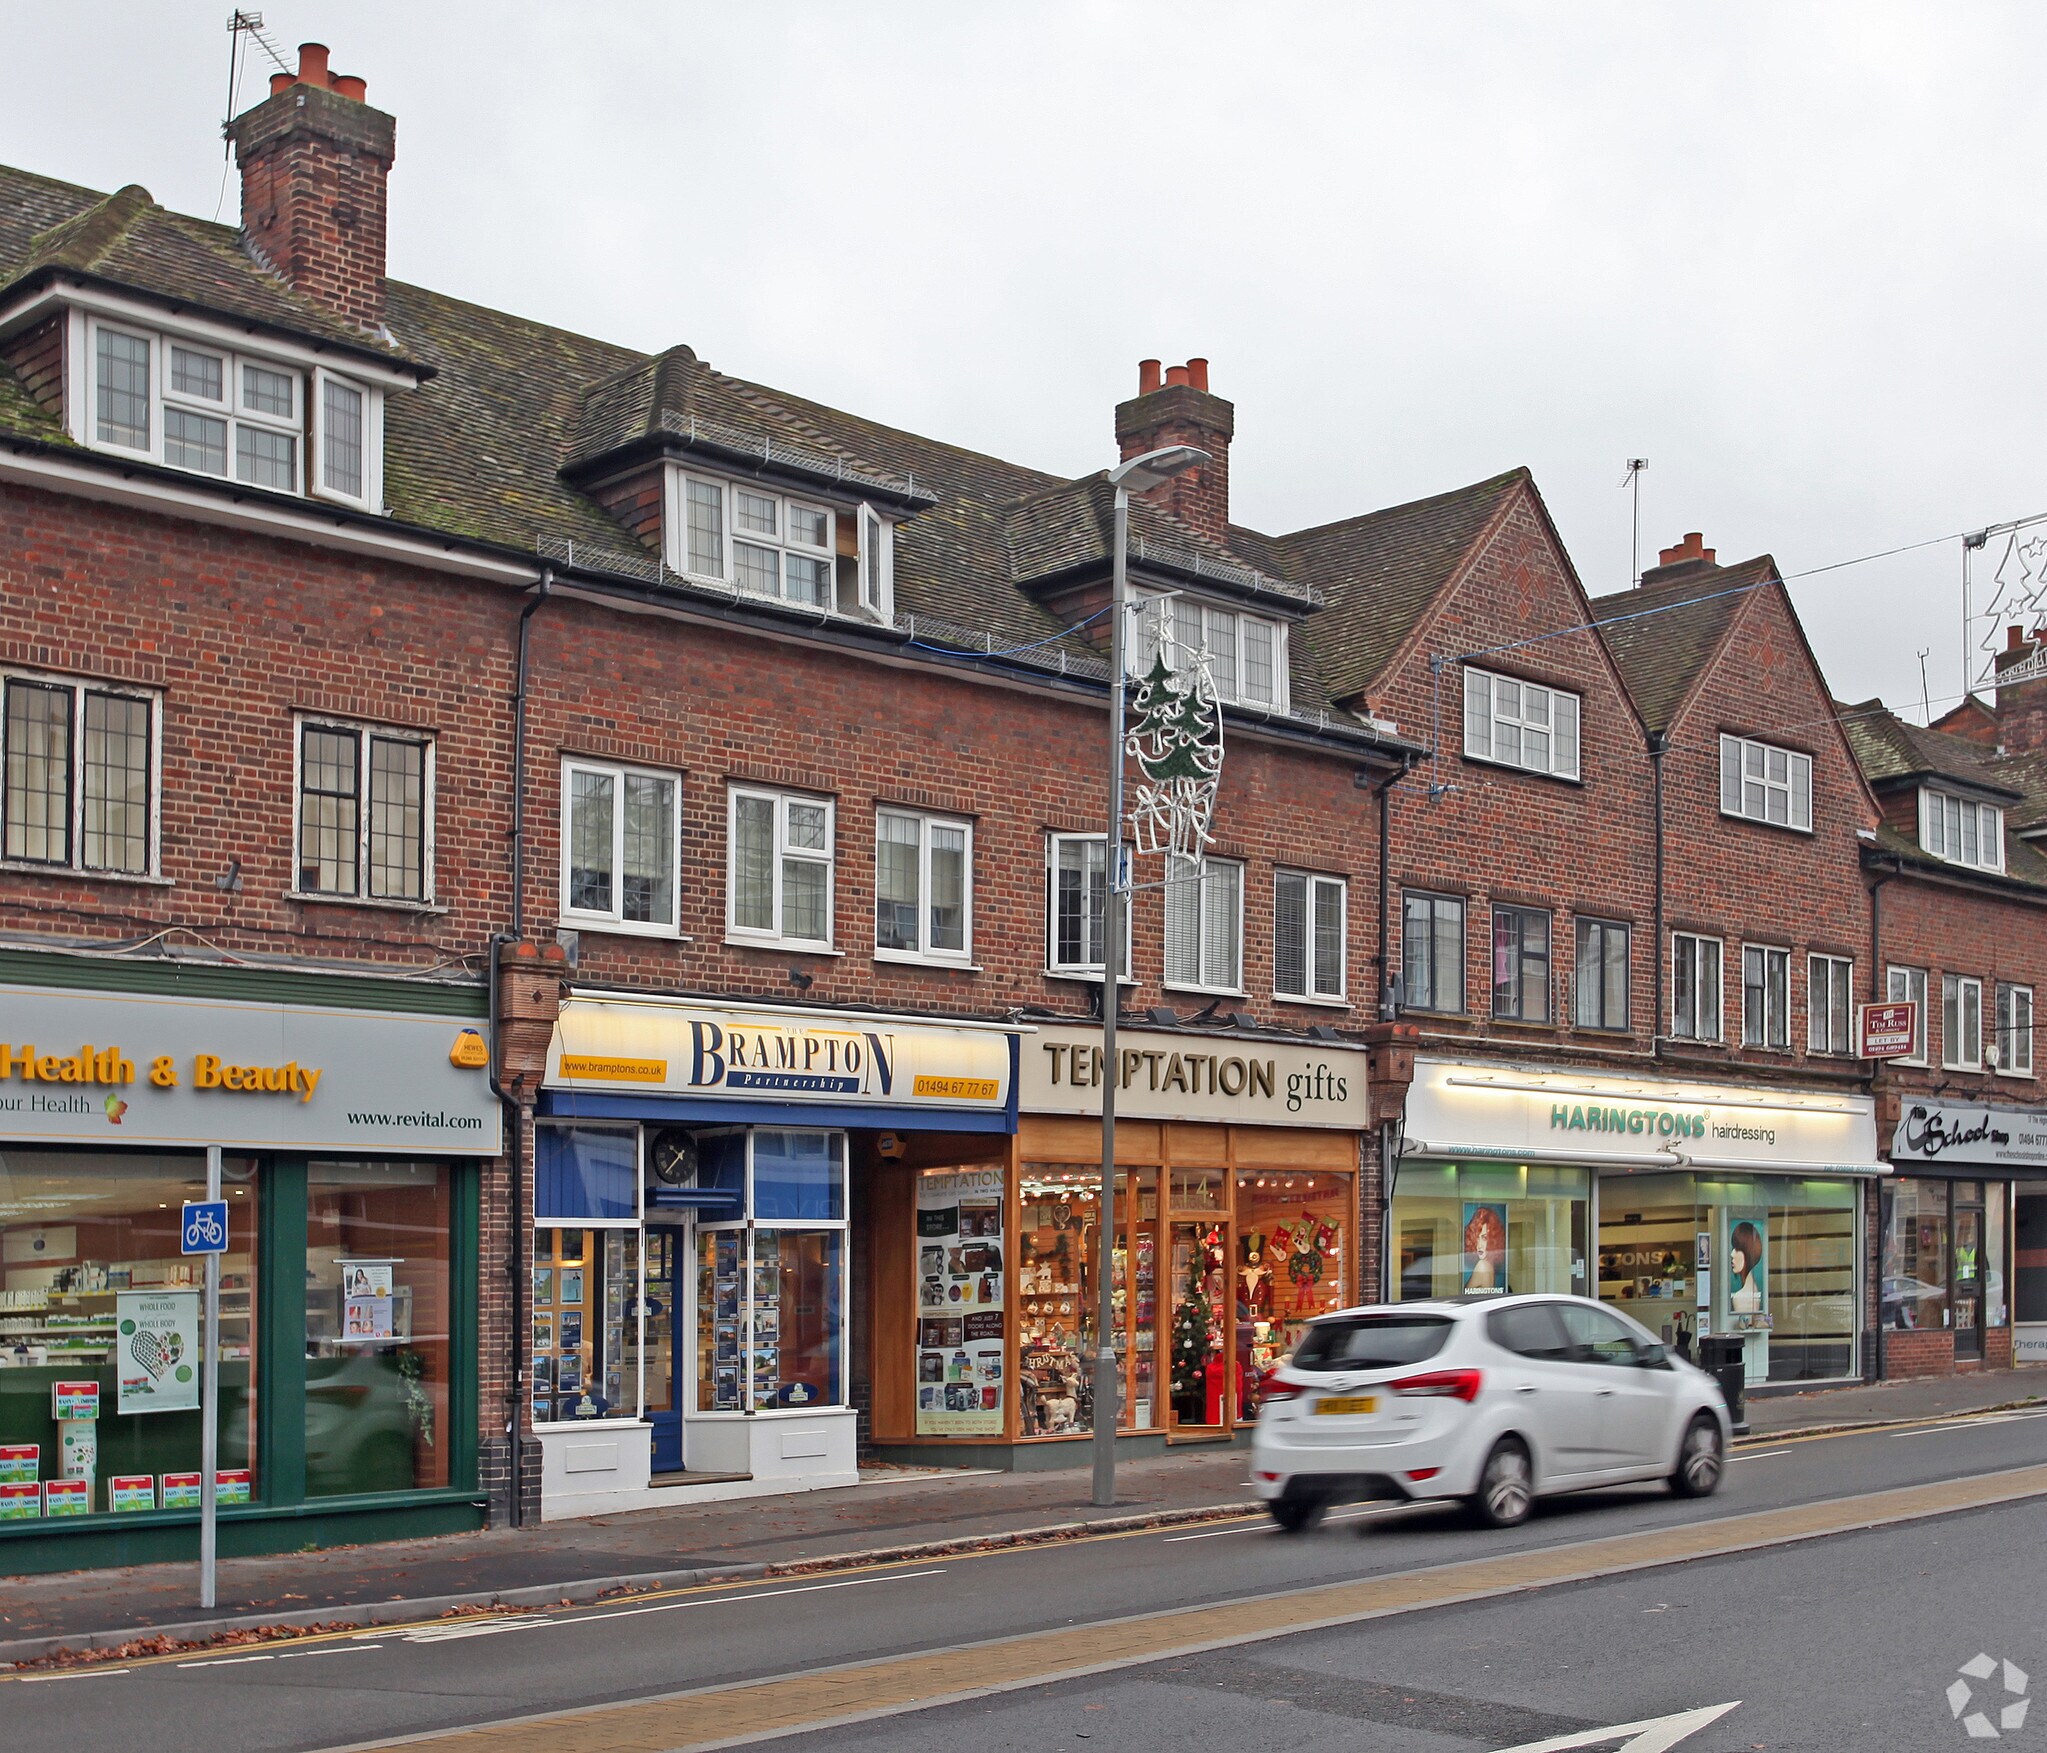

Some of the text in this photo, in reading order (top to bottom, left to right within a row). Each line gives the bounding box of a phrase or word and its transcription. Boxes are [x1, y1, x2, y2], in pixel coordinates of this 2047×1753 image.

[1870, 1020, 1907, 1029] TIM RUSS
[687, 1020, 895, 1096] BRAMPTON
[0, 1044, 323, 1103] Health & Beauty
[564, 1061, 662, 1075] www.bramptons.co.uk
[1043, 1042, 1348, 1112] TEMPTATION gifts
[744, 1073, 844, 1093] Partnership
[917, 1079, 995, 1096] 01494 67 77 67
[31, 1095, 91, 1113] Health
[347, 1111, 483, 1129] www.revital.com
[1551, 1104, 1776, 1145] HARINGTONS hairdressing
[1922, 1110, 1990, 1157] School
[918, 1171, 1004, 1191] TEMPTATION
[1464, 1287, 1504, 1295] HARINGTONS
[160, 1302, 176, 1311] FOOD
[160, 1319, 176, 1328] BODY
